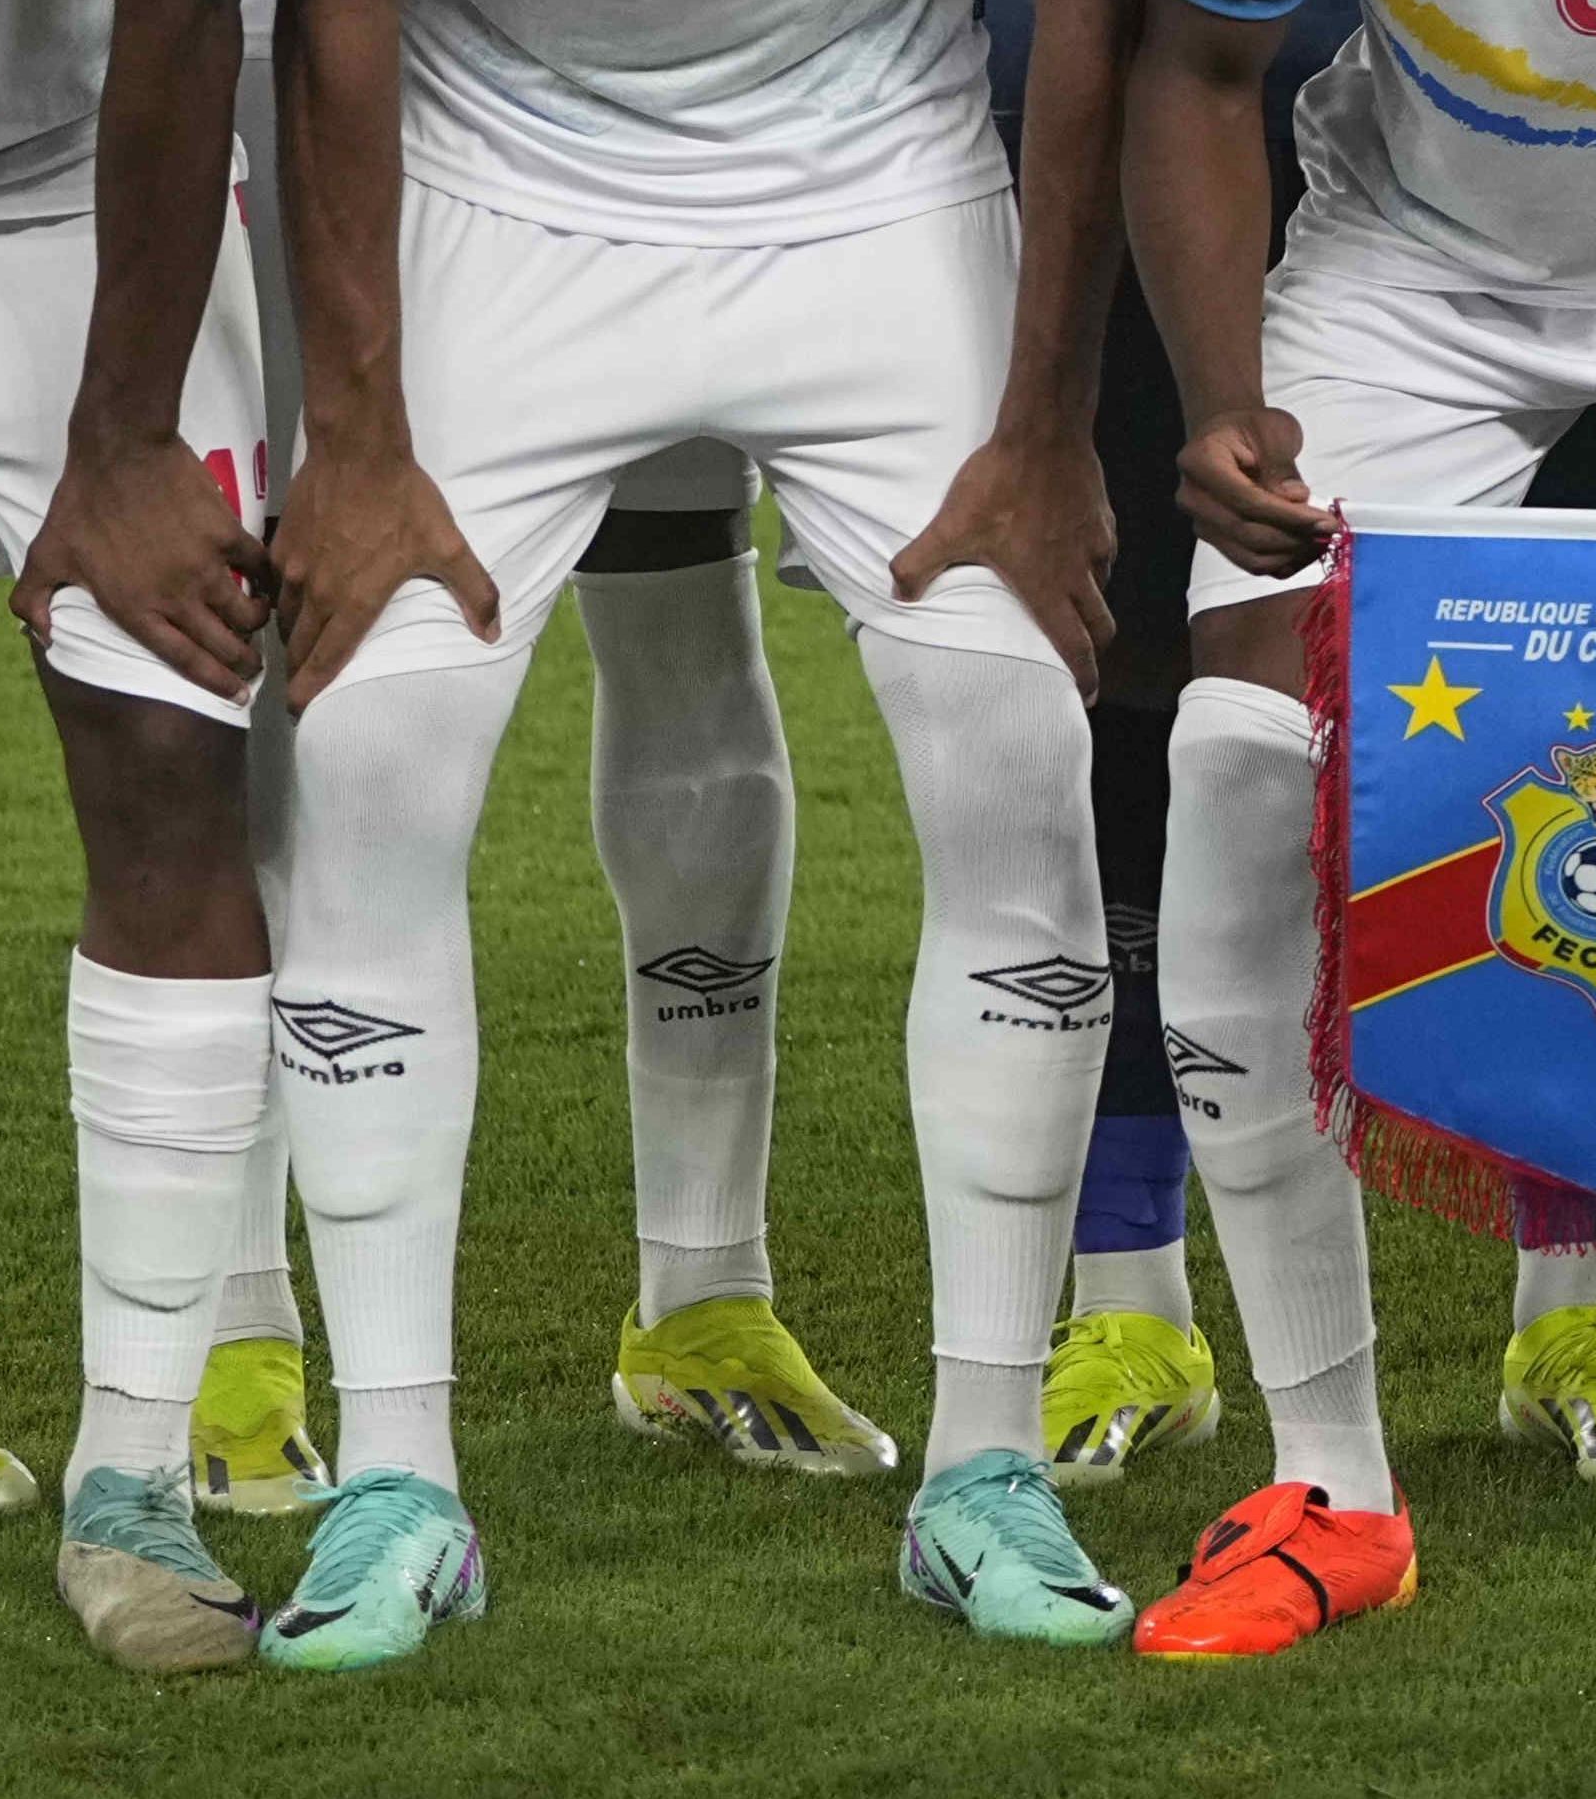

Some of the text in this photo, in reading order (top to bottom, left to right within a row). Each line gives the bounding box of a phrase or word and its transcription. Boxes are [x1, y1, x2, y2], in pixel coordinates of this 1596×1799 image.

[1435, 598, 1593, 626] REPUBLIQUE
[1523, 630, 1573, 662] DU
[658, 996, 761, 1022] umbro
[980, 1009, 1111, 1032] umbro
[279, 1053, 405, 1086] umbro
